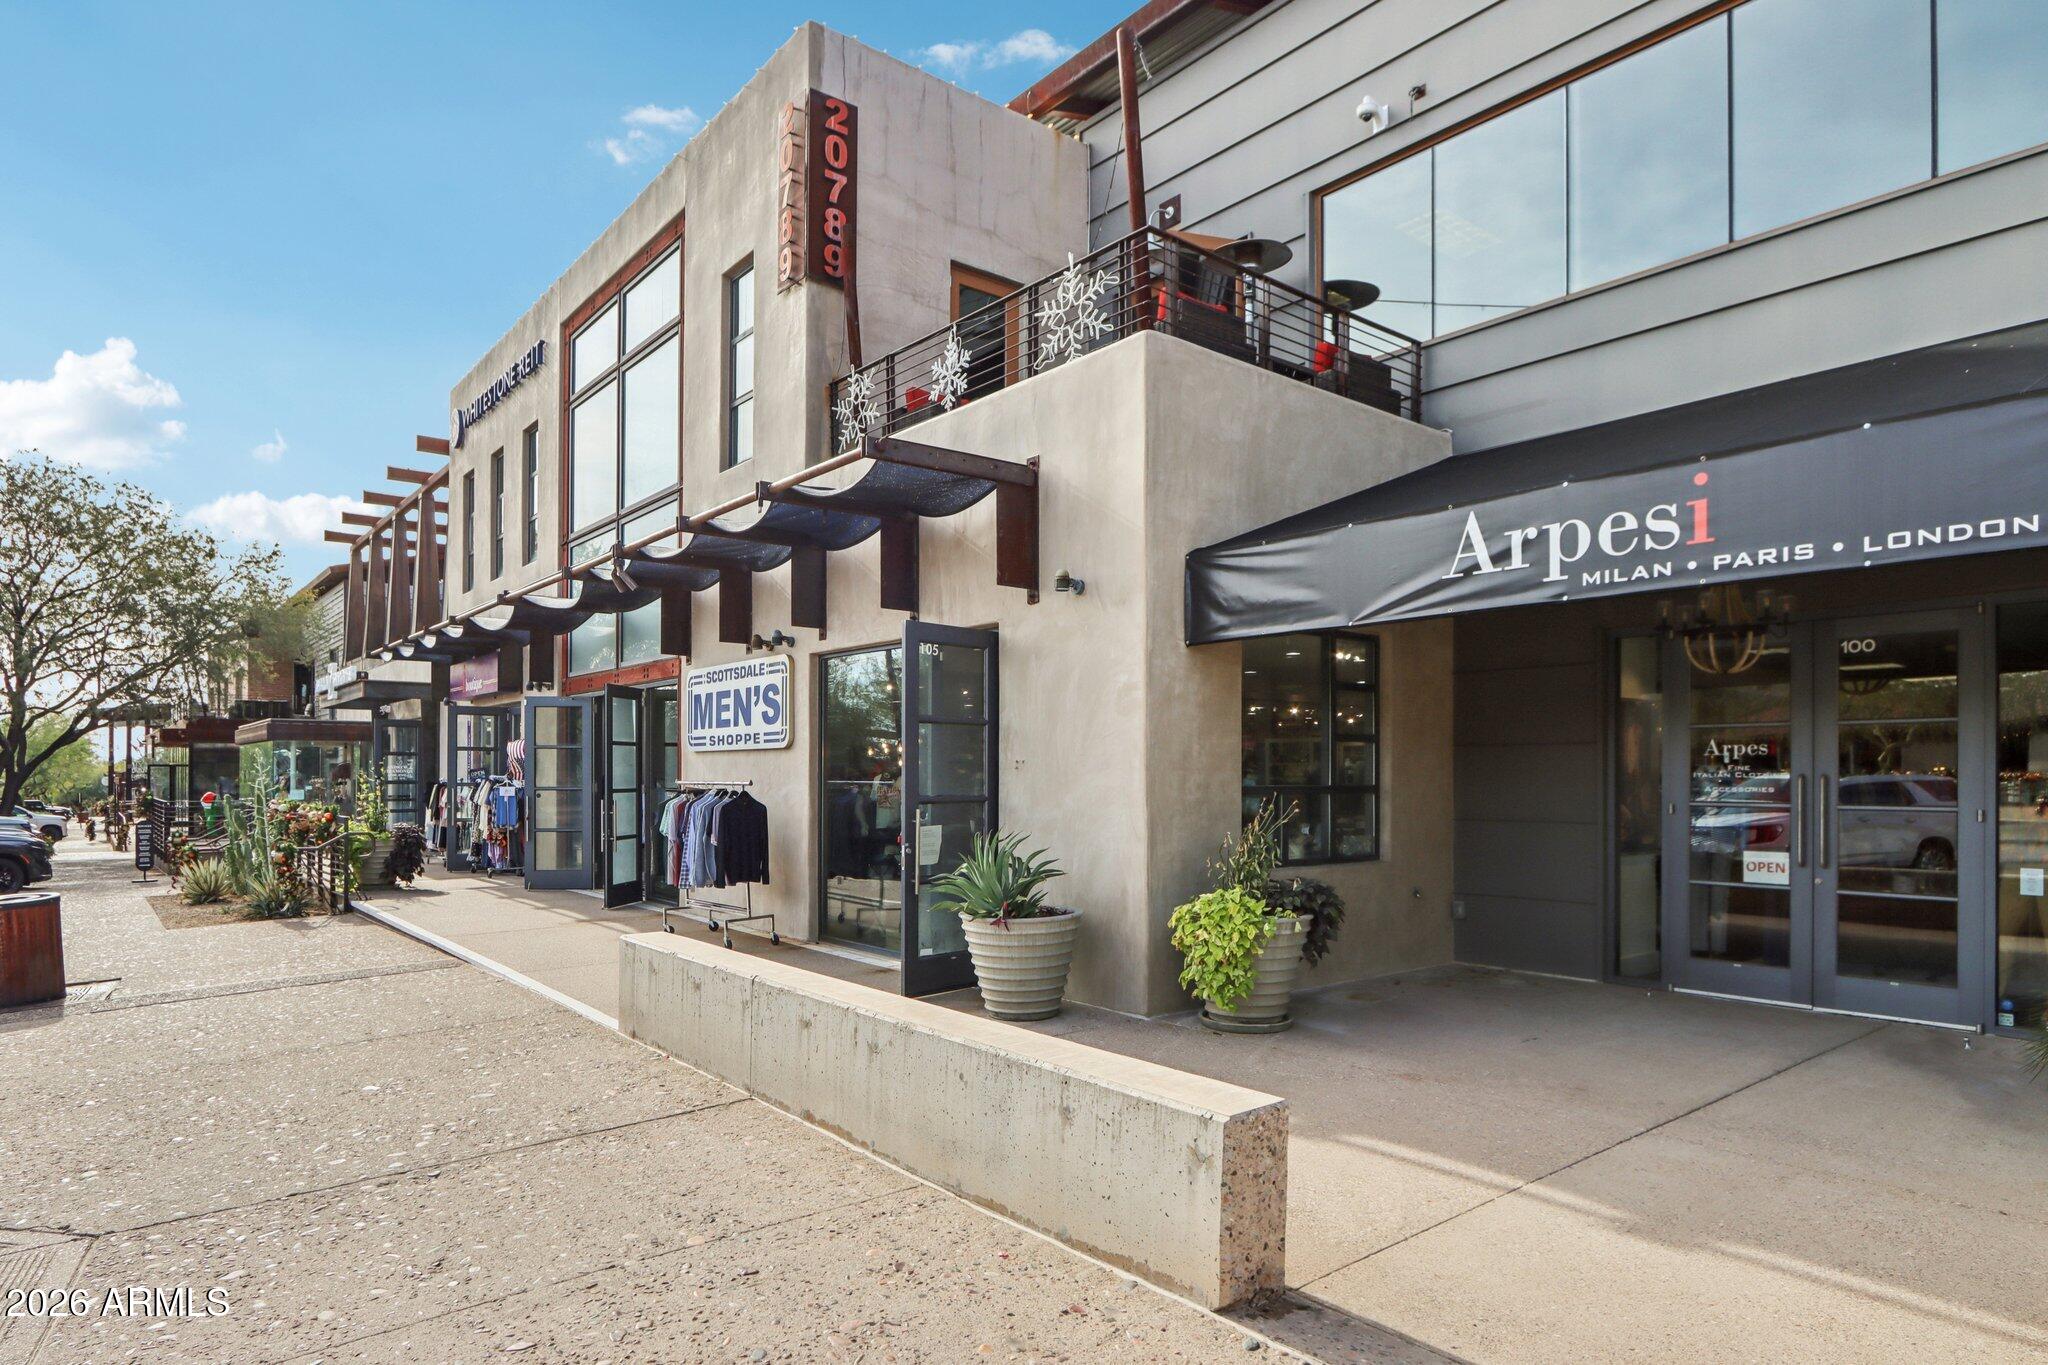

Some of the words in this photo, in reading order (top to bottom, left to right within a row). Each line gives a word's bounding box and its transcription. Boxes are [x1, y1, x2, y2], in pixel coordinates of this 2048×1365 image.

[779, 102, 793, 282] 20789
[824, 98, 848, 278] 20789
[462, 364, 518, 429] WHITESTONE
[518, 340, 545, 379] REIT
[1441, 472, 1716, 582] Arpesi
[1582, 561, 1672, 586] MILAN
[1713, 543, 1814, 570] PARIS
[1863, 514, 2039, 552] LONDON
[919, 642, 939, 656] 105
[1841, 639, 1876, 654] 100
[706, 663, 765, 684] SCOTTSDALE
[693, 683, 780, 730] MEN'S
[709, 732, 760, 746] SHOPPE
[1746, 861, 1786, 874] OPEN
